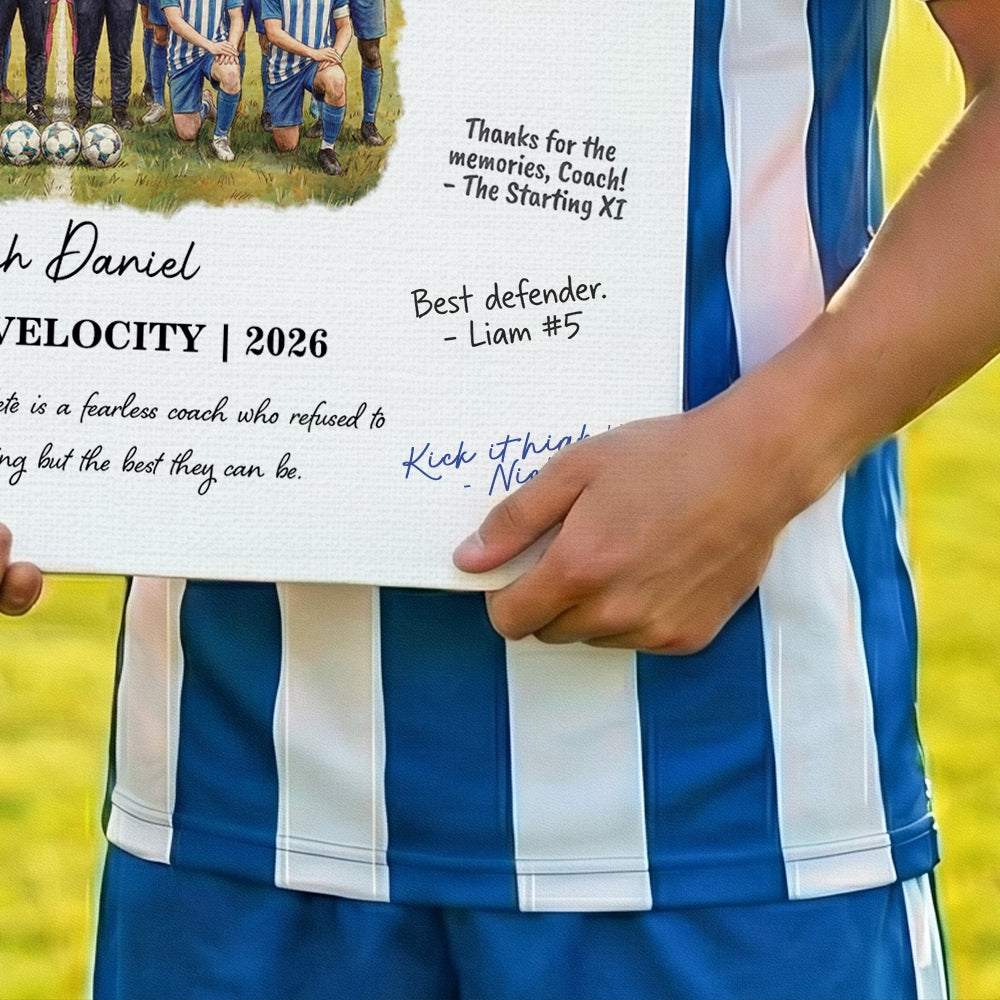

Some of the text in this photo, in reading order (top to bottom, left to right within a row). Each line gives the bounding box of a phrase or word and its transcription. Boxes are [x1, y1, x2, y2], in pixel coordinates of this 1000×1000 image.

[465, 117, 617, 163] Thanks for the
[448, 149, 629, 196] memories, Coach!
[462, 174, 500, 202] The
[505, 182, 596, 222] Starting
[598, 194, 628, 221] XI
[44, 218, 201, 284] Daniel
[410, 274, 607, 320] Best defender.
[245, 325, 328, 359] 2026
[469, 319, 532, 348] Liam
[541, 310, 584, 340] #5
[29, 394, 48, 415] is
[55, 403, 72, 416] a
[79, 390, 159, 424] fearless
[167, 395, 229, 423] coach
[236, 397, 280, 425] who
[288, 399, 368, 434] refused
[369, 406, 386, 430] to
[37, 441, 75, 472] but
[78, 444, 111, 473] the
[121, 445, 166, 476] best
[169, 448, 218, 497] they
[223, 464, 266, 478] can
[275, 451, 302, 480] be.
[401, 440, 478, 481] Kick
[488, 434, 522, 464] it
